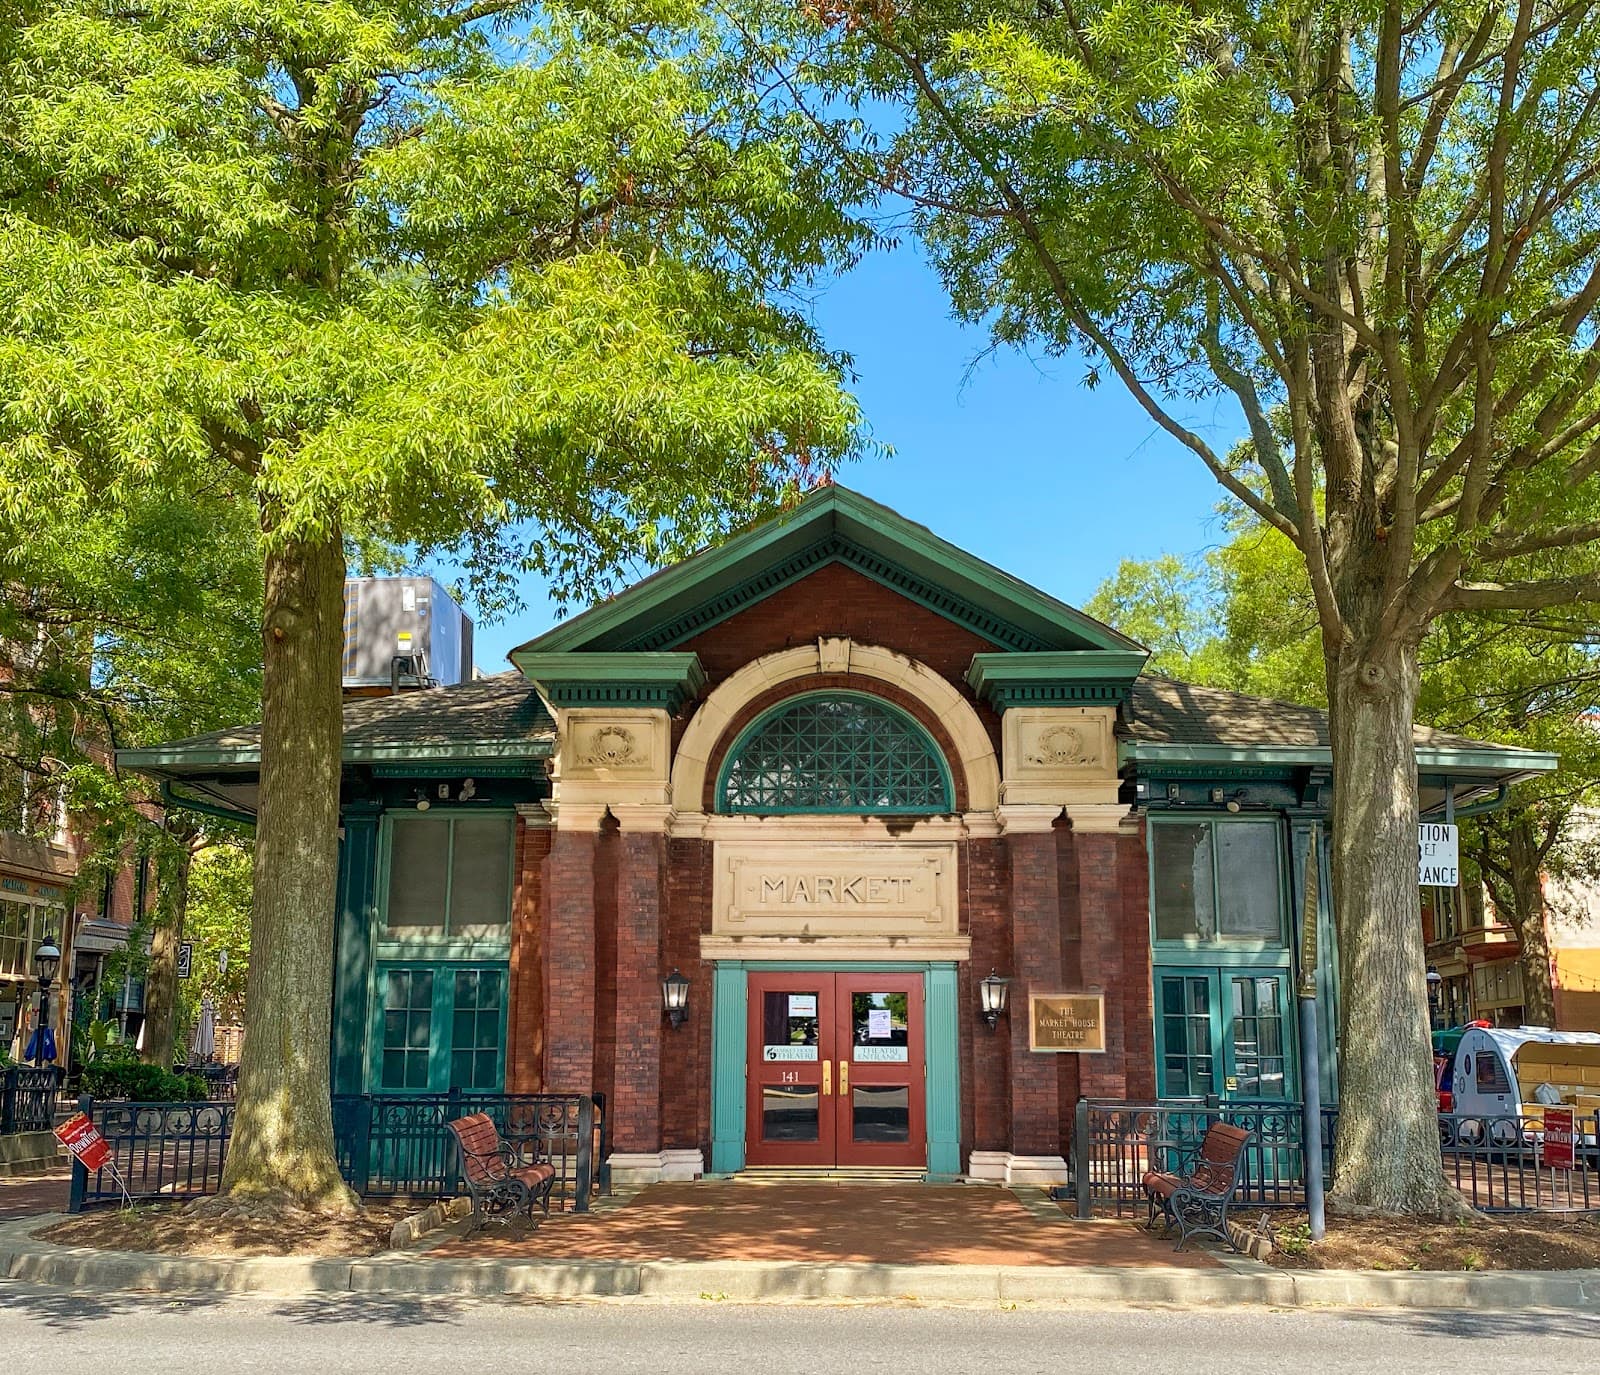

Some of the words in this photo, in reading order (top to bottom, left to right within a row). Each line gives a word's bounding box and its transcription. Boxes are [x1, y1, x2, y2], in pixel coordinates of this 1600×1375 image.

[760, 875, 912, 903] MARKET
[1060, 1007, 1075, 1016] THE
[1039, 1018, 1067, 1027] MARKET
[1072, 1018, 1096, 1027] HOUSE
[1052, 1031, 1084, 1039] THEATRE
[782, 1071, 799, 1083] 141
